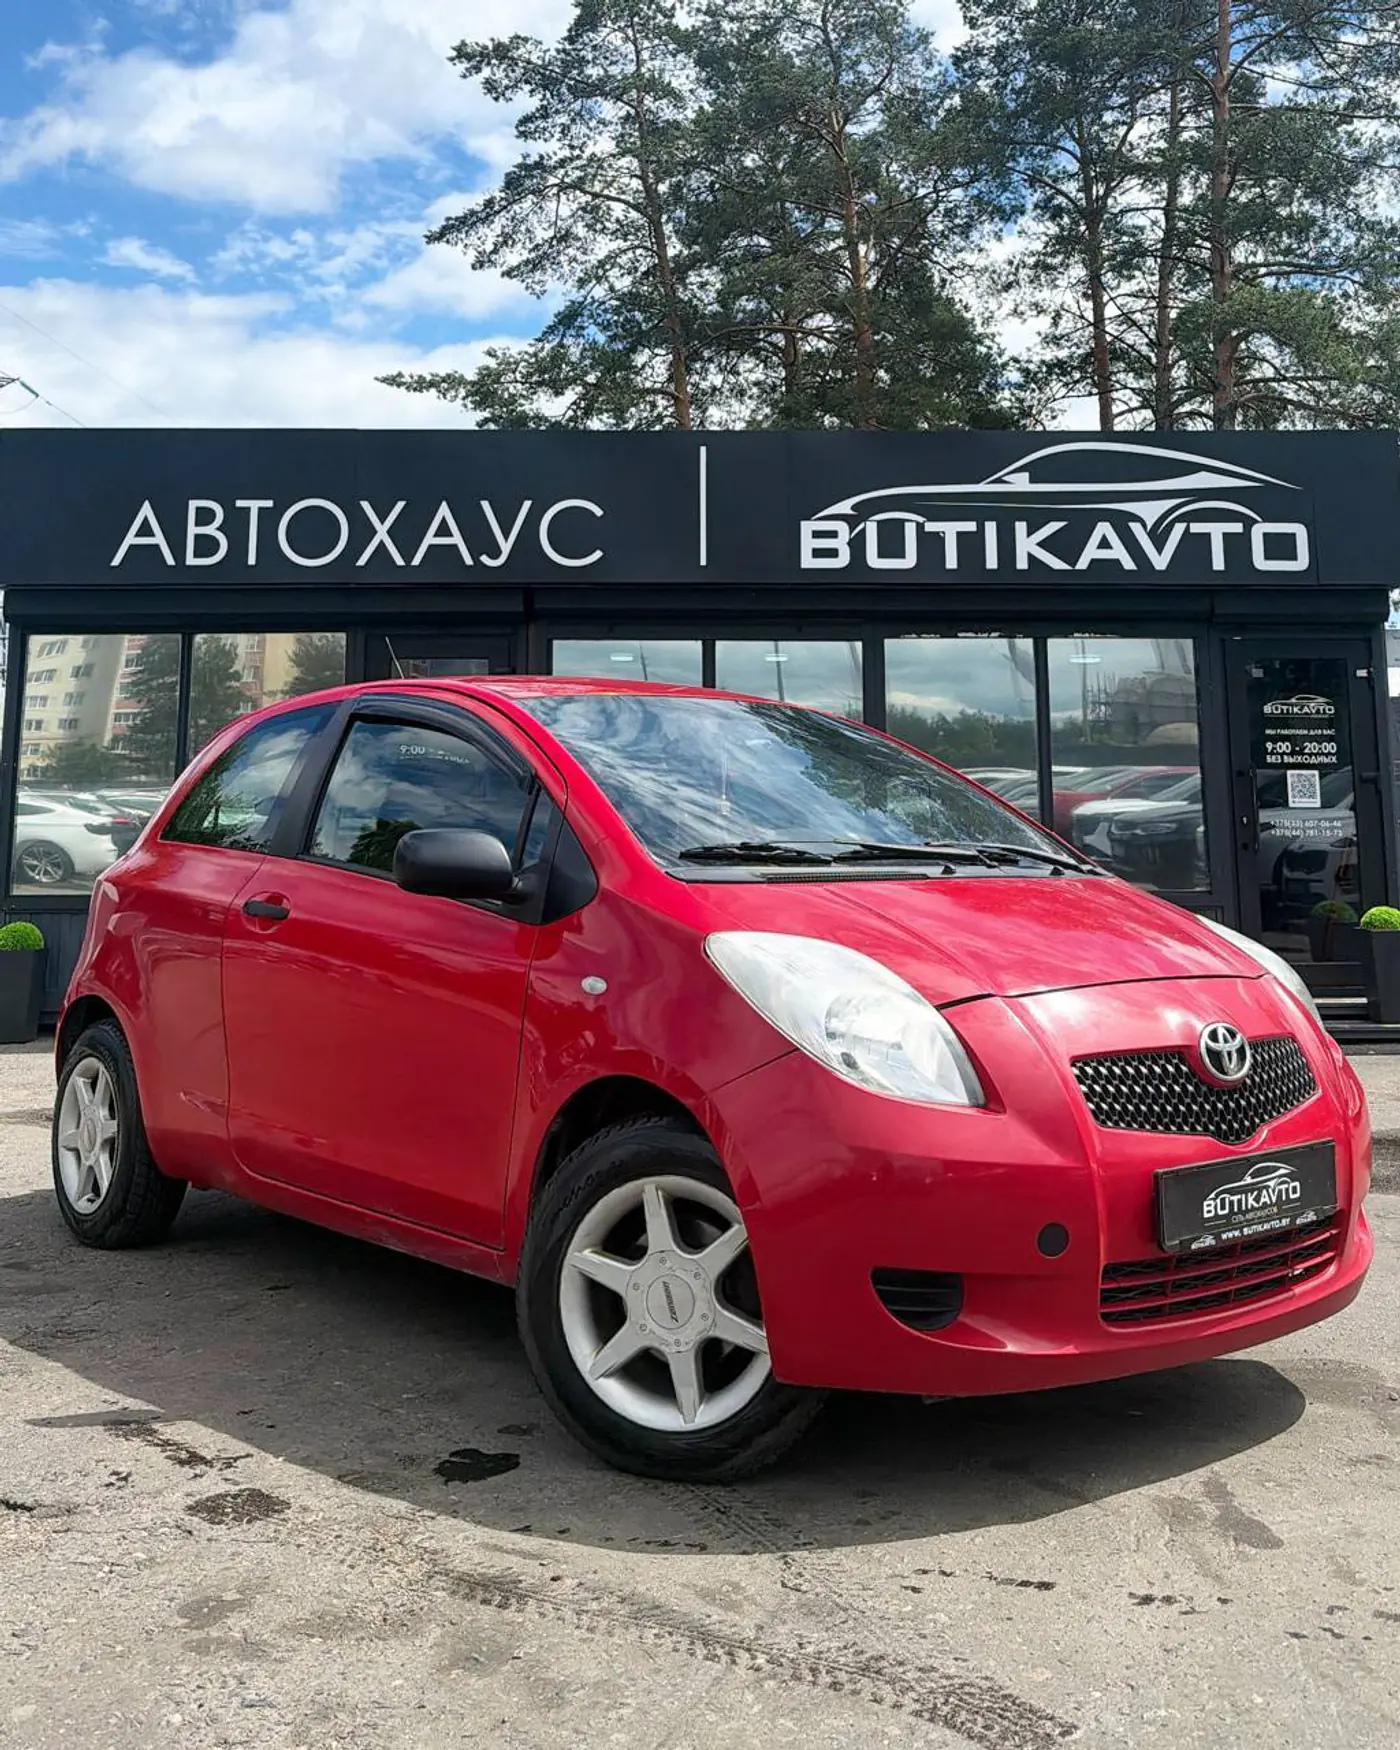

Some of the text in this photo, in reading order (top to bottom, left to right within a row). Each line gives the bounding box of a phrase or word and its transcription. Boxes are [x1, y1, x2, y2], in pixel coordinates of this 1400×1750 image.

[110, 498, 605, 568] АВТОХАУС
[800, 520, 1310, 572] BUTIKAVTO
[1263, 705, 1335, 714] BUTIKAVTO
[1266, 742, 1291, 753] 9:00
[1303, 742, 1337, 753] 20:00
[1266, 755, 1338, 764] БЕЗ ВЫХОДНЫХ
[1203, 1182, 1300, 1218] BUTIKAVTO
